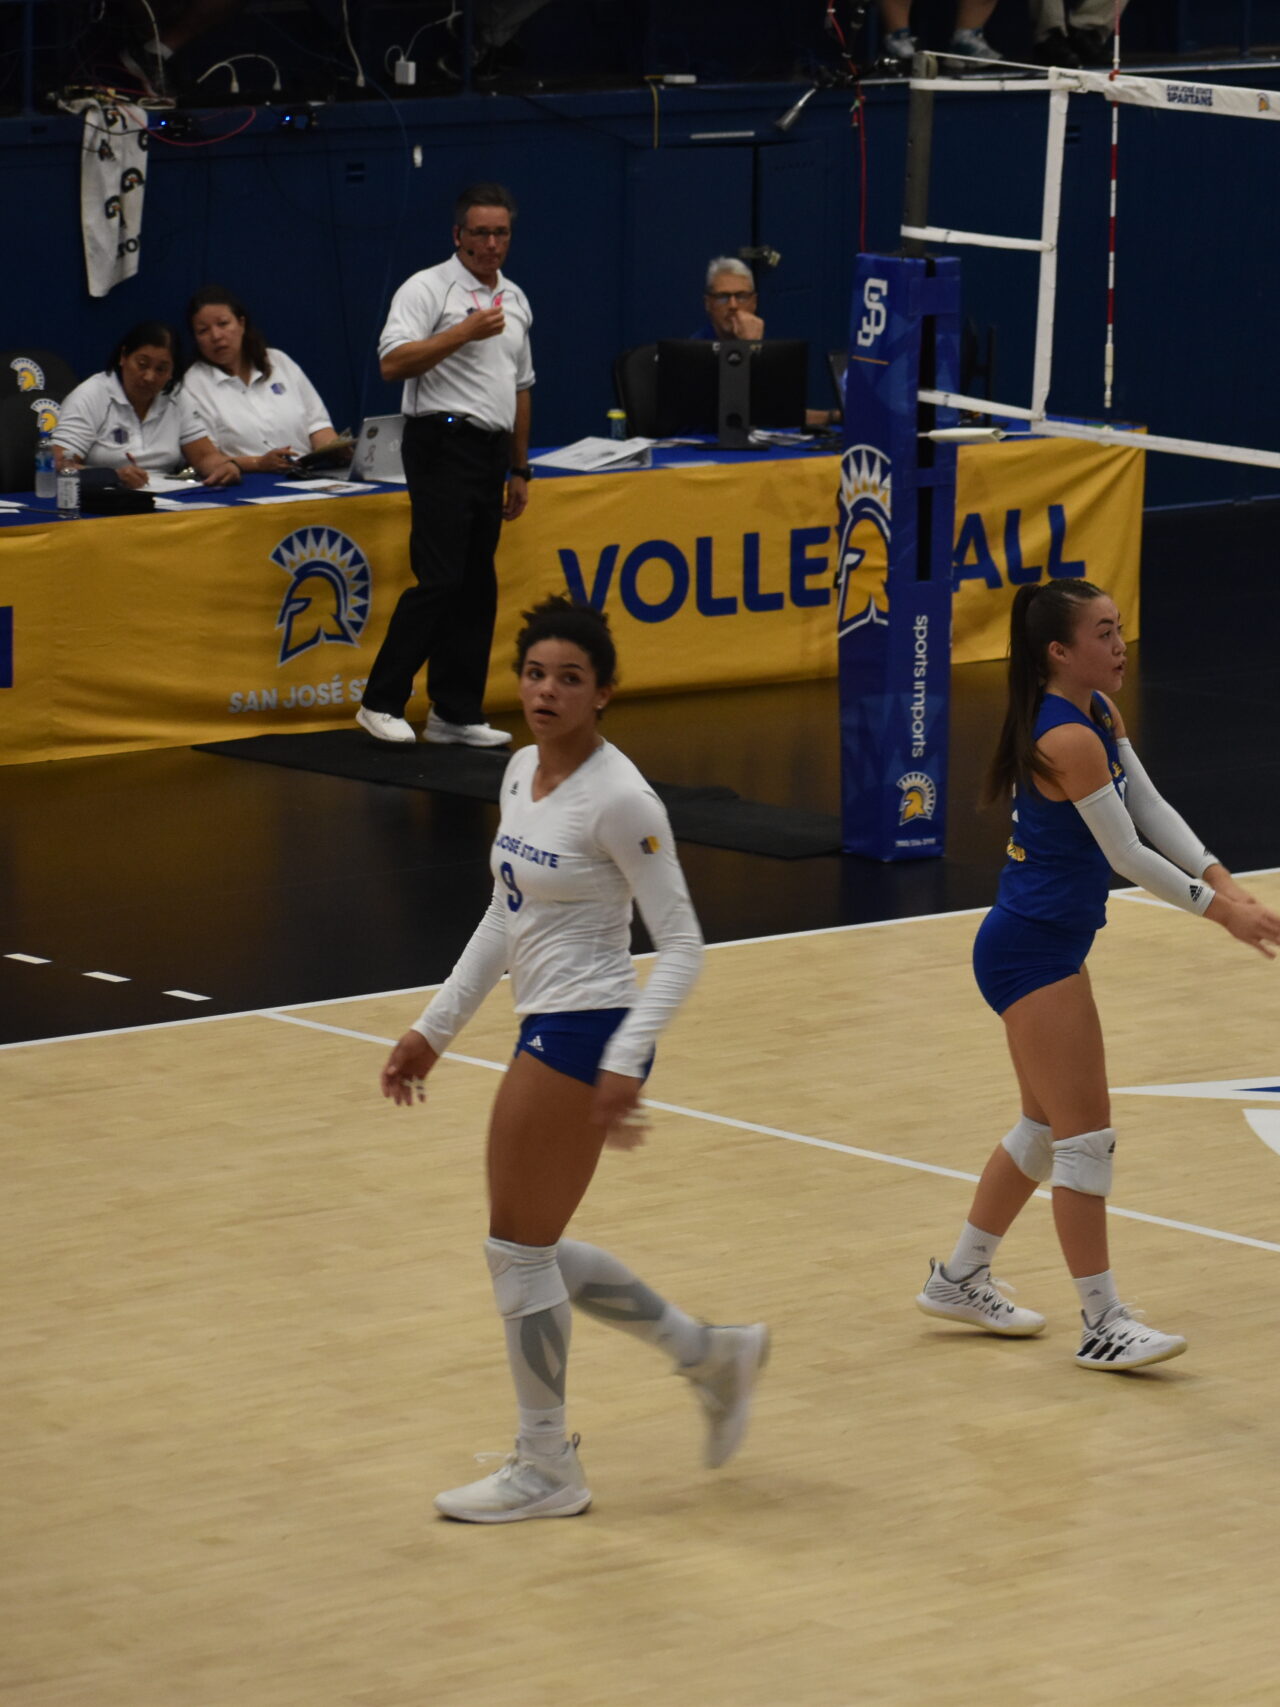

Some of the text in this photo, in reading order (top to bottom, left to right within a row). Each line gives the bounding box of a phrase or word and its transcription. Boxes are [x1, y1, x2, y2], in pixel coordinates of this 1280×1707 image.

[557, 505, 1086, 623] VOLLEALL
[228, 688, 278, 713] SAN
[283, 673, 344, 708] JOSÉ
[910, 615, 928, 758] sports imports
[520, 844, 559, 868] STATE
[500, 861, 523, 912] 9
